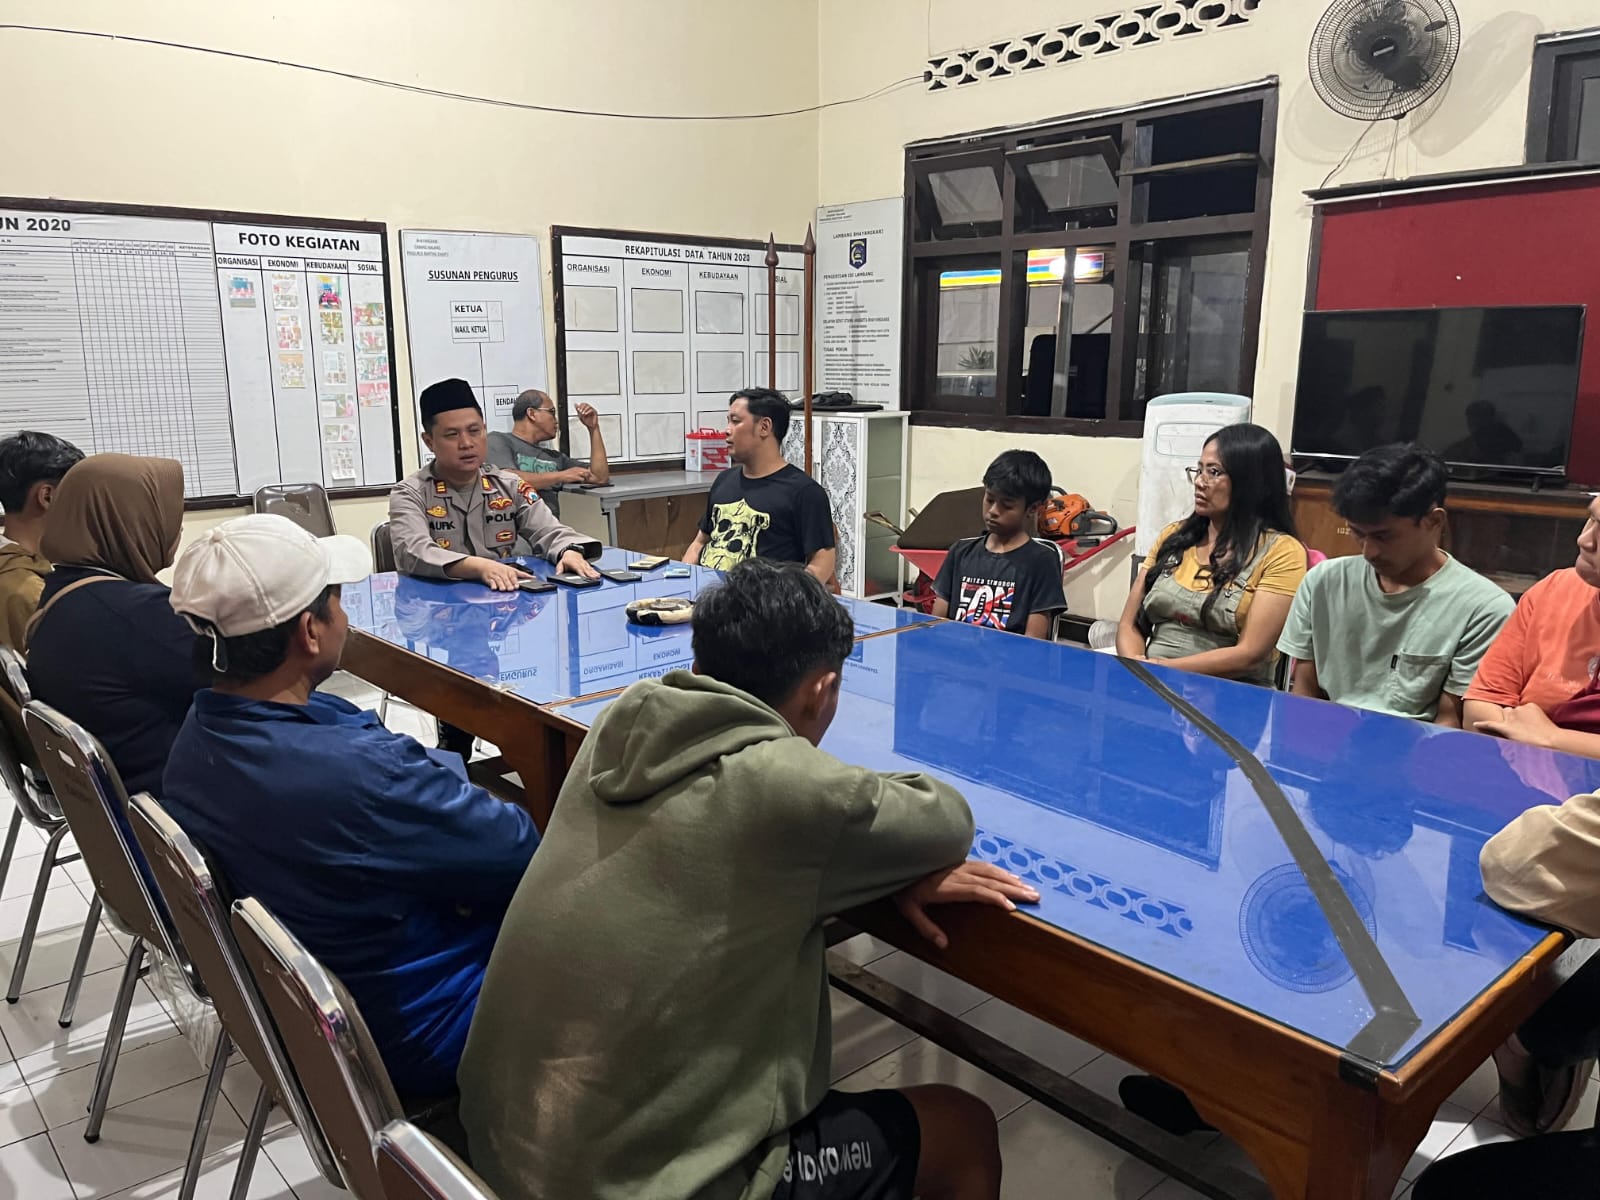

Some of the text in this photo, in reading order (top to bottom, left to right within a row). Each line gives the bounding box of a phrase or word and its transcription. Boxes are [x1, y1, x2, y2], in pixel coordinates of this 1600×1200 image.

[26, 218, 71, 231] 2020
[238, 232, 361, 252] FOTO KEGIATAN
[625, 245, 681, 258] REKAPITULASI
[685, 249, 704, 260] DATA
[708, 251, 733, 262] TAHUN
[217, 256, 259, 267] ORGANISASI
[267, 259, 299, 268] EKONOMI
[306, 261, 347, 271] KEBUDAYAAN
[357, 263, 379, 272] SOSIAL
[566, 263, 610, 274] ORGANISASI
[641, 267, 672, 277] EKONOMI
[428, 269, 519, 281] SUSUNAN PENGURUS
[699, 271, 739, 281] KEBUDAYAAN
[454, 305, 483, 313] KETUA
[454, 325, 488, 334] WAKIL KETUA
